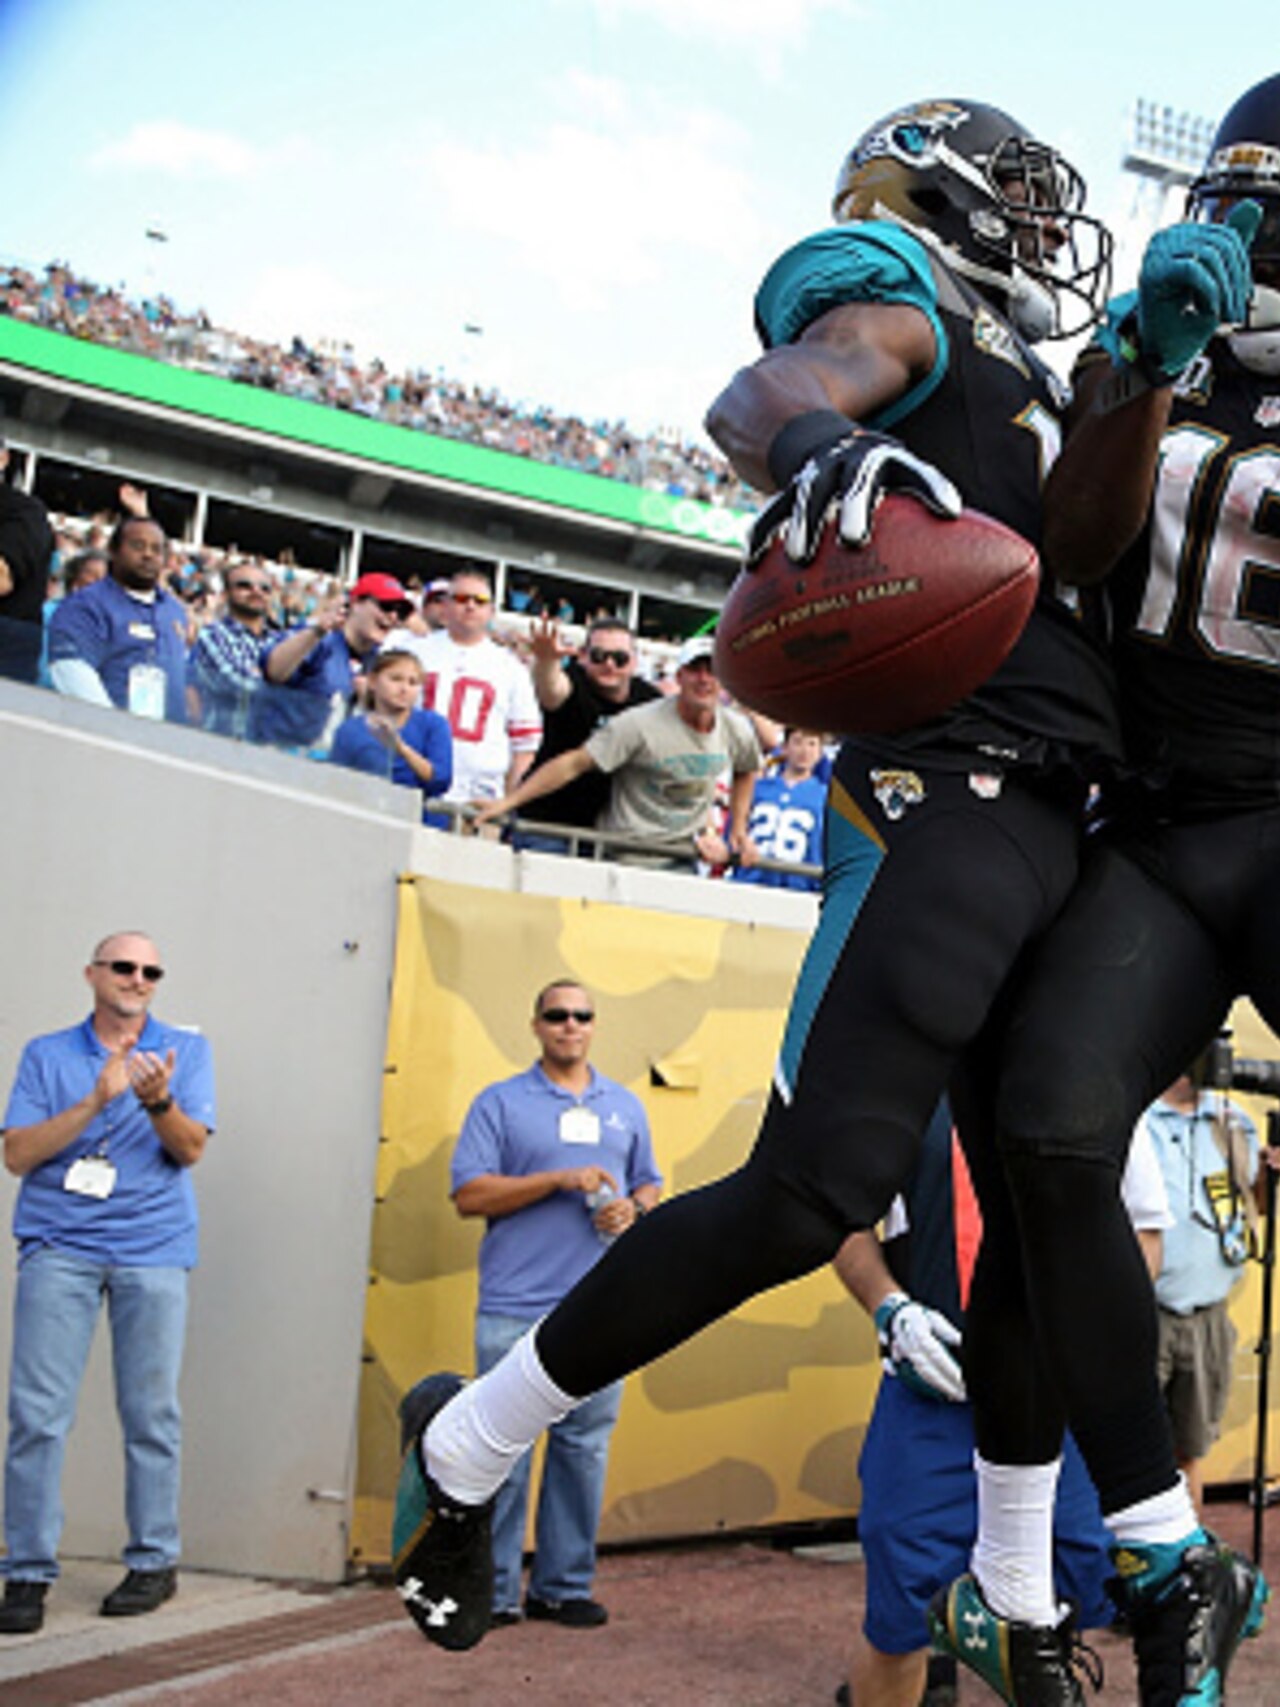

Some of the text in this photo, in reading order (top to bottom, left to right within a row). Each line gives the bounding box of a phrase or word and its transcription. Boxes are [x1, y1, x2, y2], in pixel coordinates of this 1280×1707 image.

[856, 575, 923, 604] LEAGUE
[421, 671, 497, 743] 10
[750, 802, 815, 862] 26
